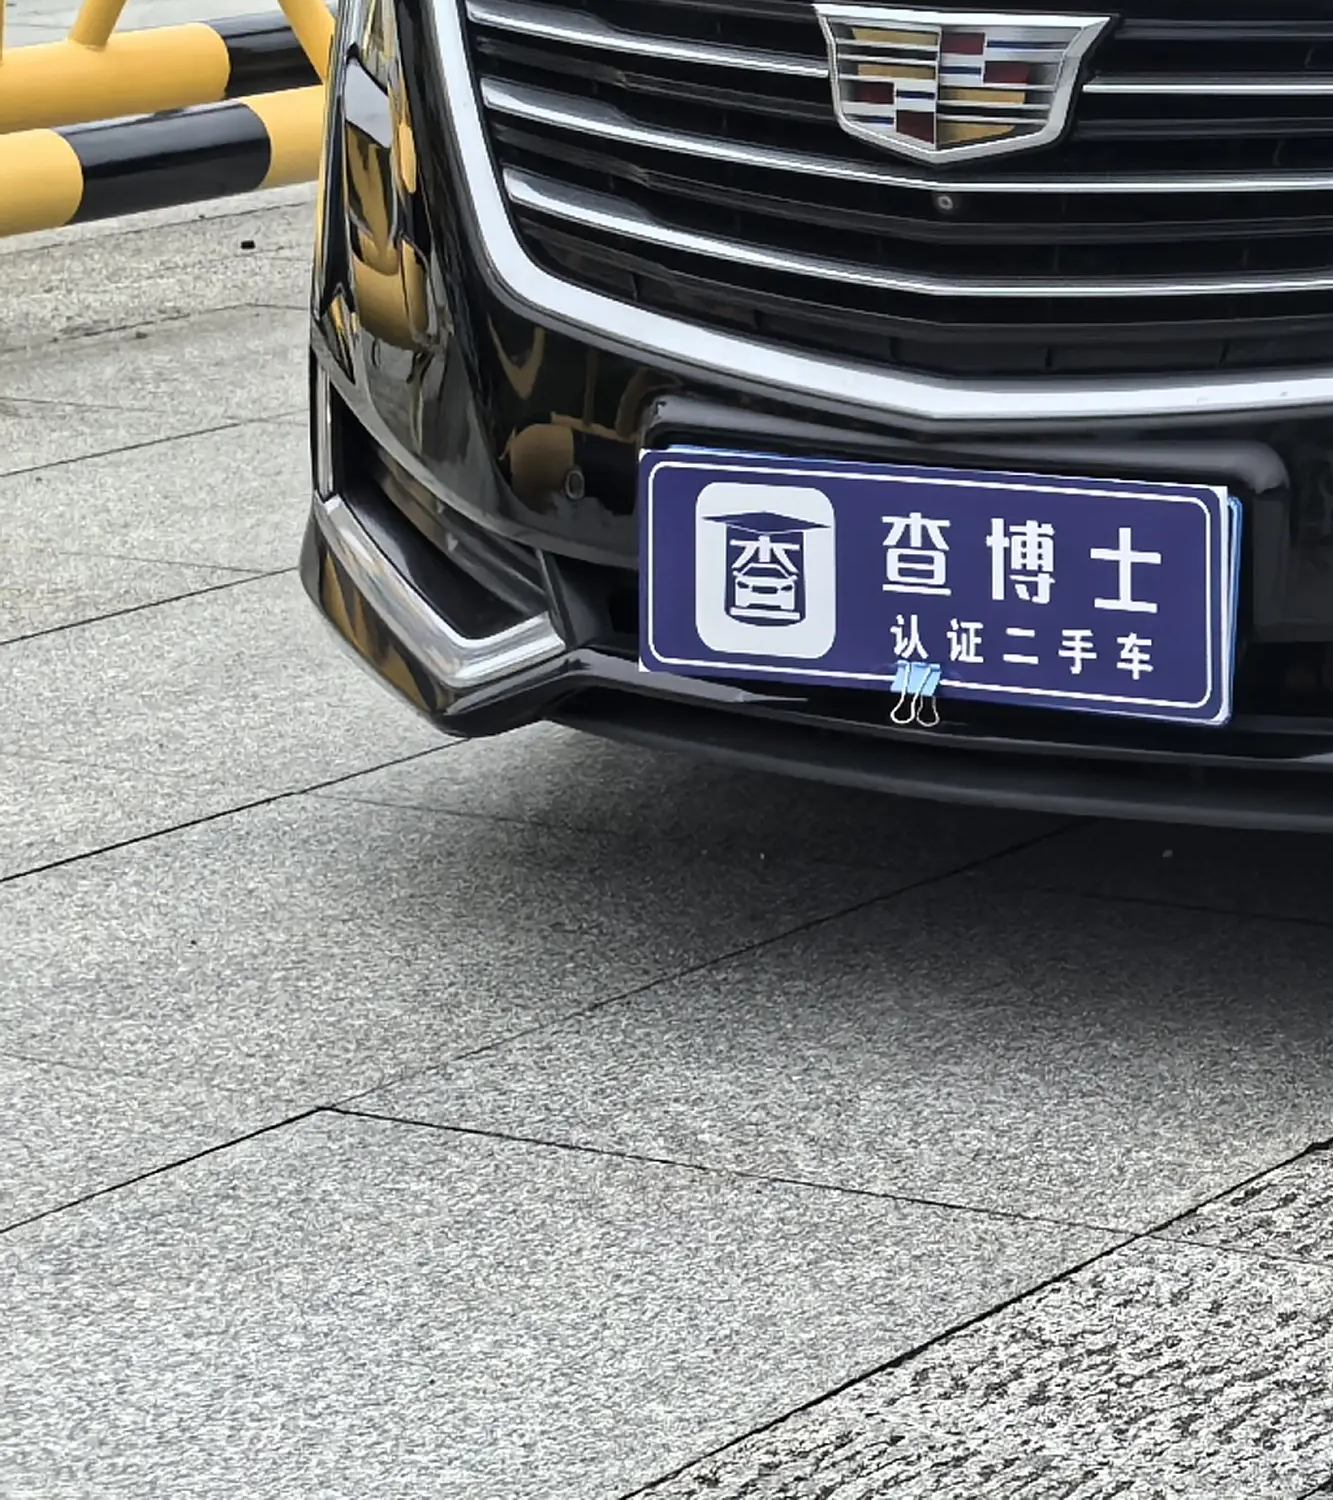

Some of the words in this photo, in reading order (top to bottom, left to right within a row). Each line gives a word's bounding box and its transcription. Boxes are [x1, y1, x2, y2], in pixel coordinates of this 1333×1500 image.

[881, 511, 1162, 614] 查博士
[890, 614, 1155, 681] 认证二手车
